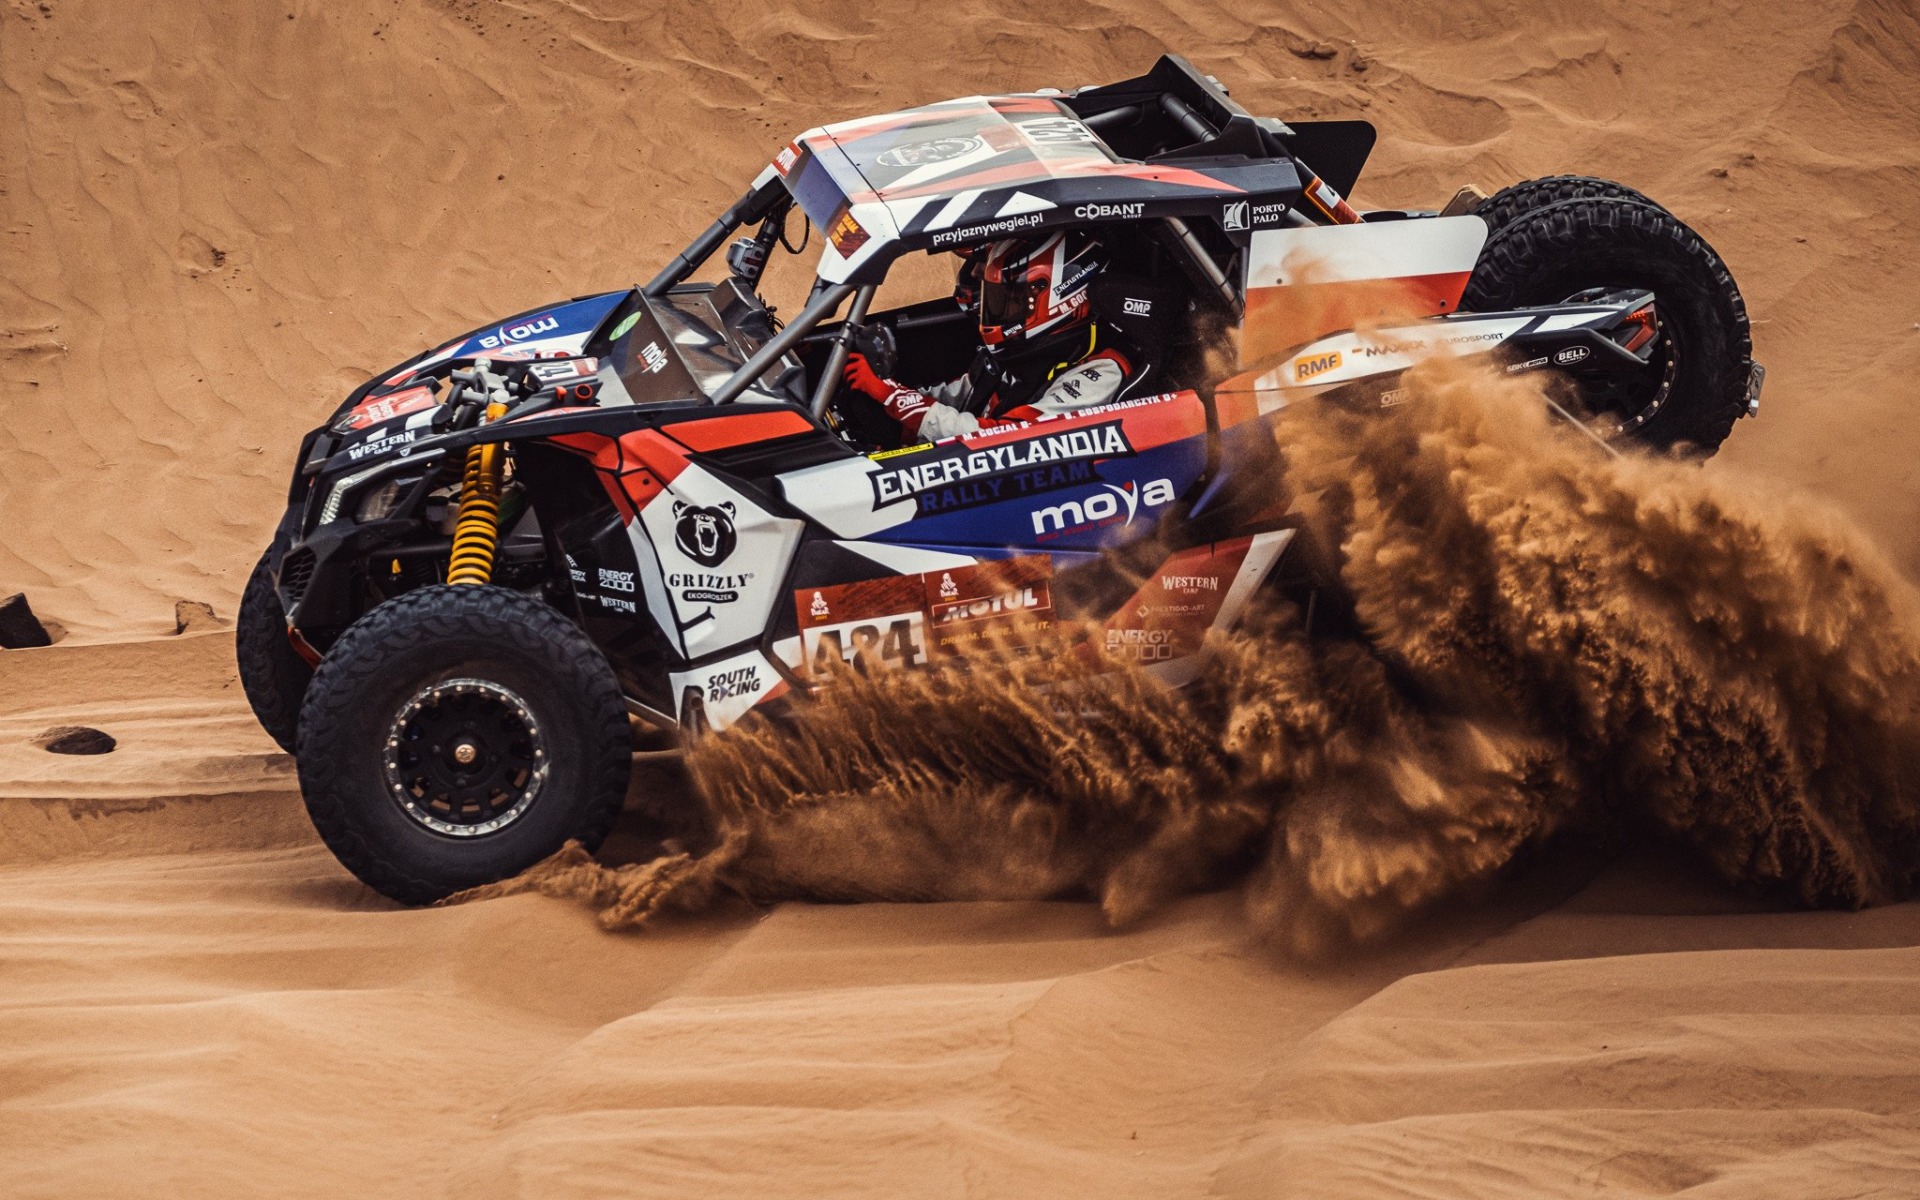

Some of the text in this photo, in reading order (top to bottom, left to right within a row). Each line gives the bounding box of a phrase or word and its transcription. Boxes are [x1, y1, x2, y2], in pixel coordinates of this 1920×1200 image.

[1075, 203, 1145, 219] COBANT
[1253, 203, 1285, 214] PORTO
[1253, 213, 1278, 223] PALO
[933, 213, 1043, 245] przyjaznywegiel.pl
[1123, 300, 1151, 314] OMP
[479, 316, 559, 349] moya
[1441, 332, 1504, 345] UROSPORT
[641, 341, 668, 373] moya
[1559, 348, 1586, 360] BELL
[1297, 355, 1337, 379] RMF
[896, 394, 923, 409] OMP
[963, 431, 977, 441] M.
[349, 430, 415, 459] WESTERN
[876, 425, 1128, 503] ENERGYLANDIA
[922, 460, 1091, 513] RALLY TEAM
[1031, 478, 1175, 534] moya
[599, 568, 634, 581] ENERGY
[600, 579, 634, 592] 2000
[1162, 576, 1219, 590] WESTERN
[687, 592, 733, 600] EKOGROSZEK
[600, 596, 636, 612] WESTERN
[943, 588, 1038, 621] MOTUL
[1106, 629, 1173, 643] ENERGY
[708, 665, 756, 689] SOUTH
